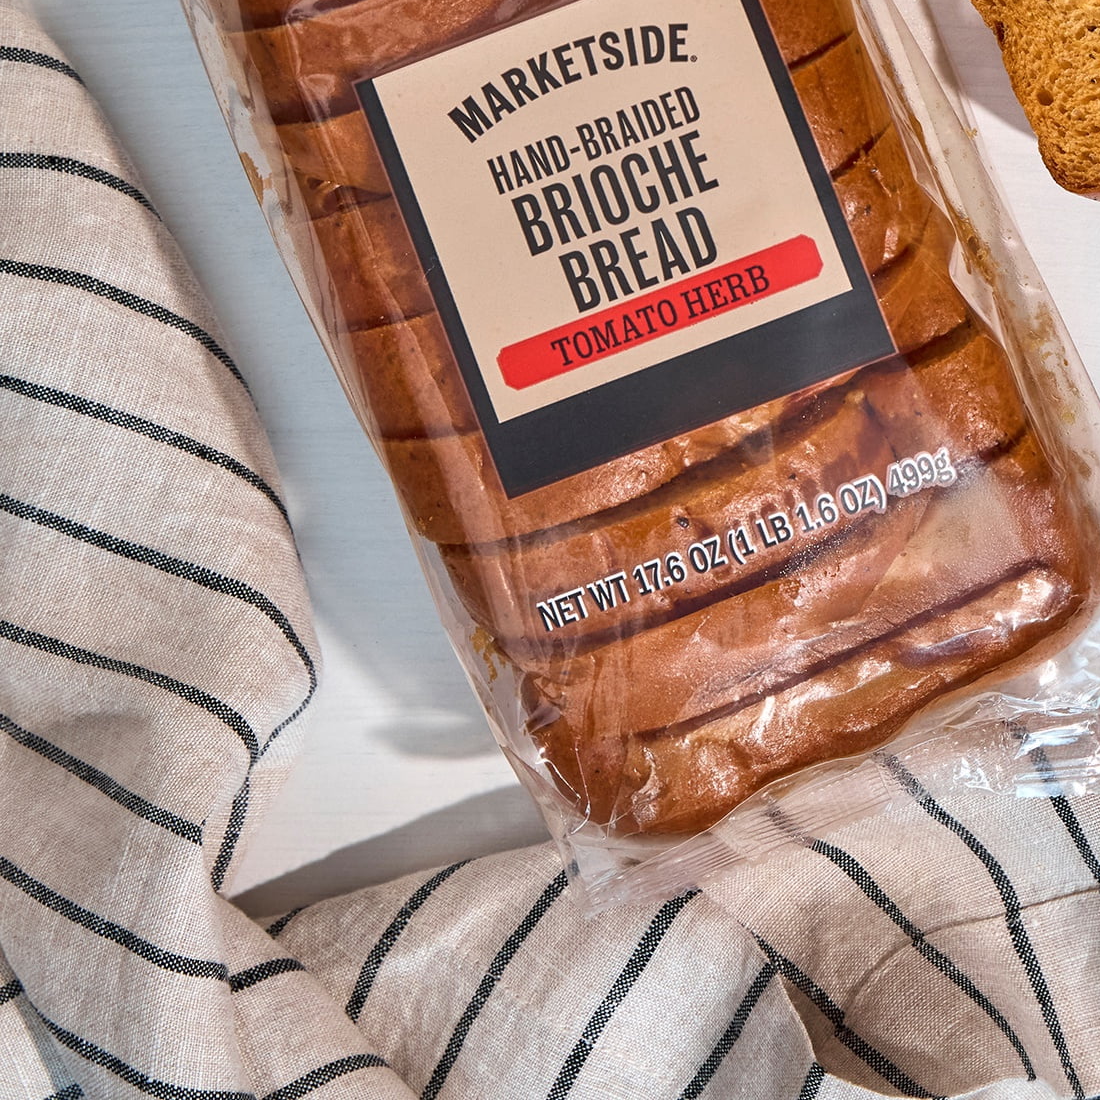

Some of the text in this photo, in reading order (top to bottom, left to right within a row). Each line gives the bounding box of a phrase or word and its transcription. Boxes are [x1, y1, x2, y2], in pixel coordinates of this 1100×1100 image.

[487, 86, 701, 195] HAND-BRAIDED
[511, 130, 719, 257] BRIOCHE
[558, 206, 718, 313] BREAD
[551, 264, 770, 367] TOMATO HERB
[537, 447, 956, 631] NET WT 17.6 OZ (1 LB 1.6 OZ) 499g
